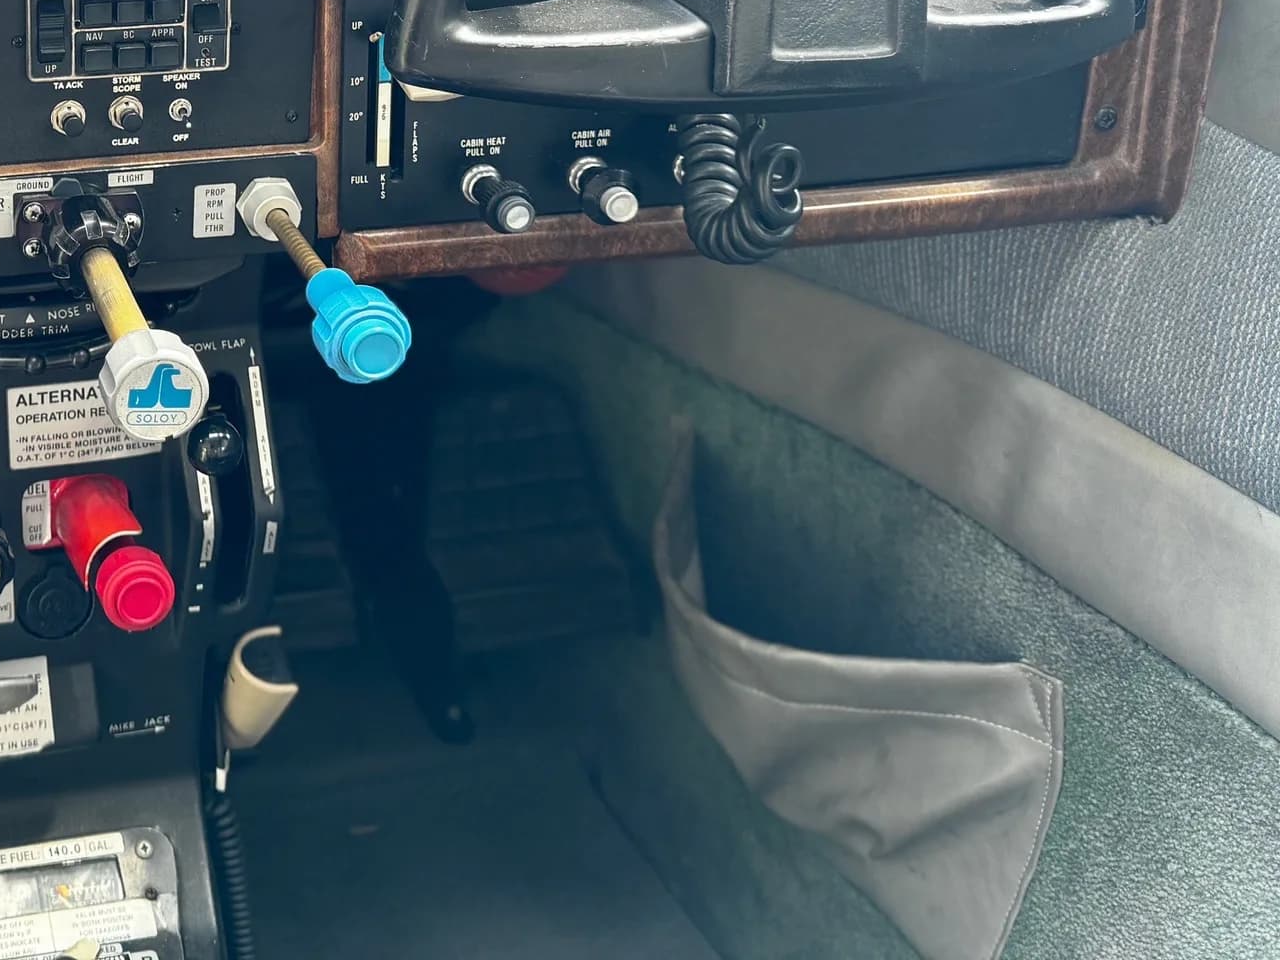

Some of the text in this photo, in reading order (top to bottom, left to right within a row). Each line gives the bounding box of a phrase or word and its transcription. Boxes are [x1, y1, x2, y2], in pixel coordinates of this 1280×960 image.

[86, 32, 103, 41] NAV
[151, 28, 175, 38] APPR
[198, 35, 213, 44] OFF
[195, 57, 216, 67] TEST
[112, 75, 141, 84] STORM
[163, 73, 200, 82] SPEAKER
[113, 83, 141, 92] SCOPE
[175, 82, 188, 90] ON
[173, 134, 189, 142] OFF
[572, 129, 611, 140] CABIN AIR
[111, 137, 139, 146] CLEAR
[461, 137, 506, 148] CABIN HEAT
[117, 173, 144, 184] FLIGHT
[16, 180, 50, 191] GROUND
[205, 187, 226, 197] PROP
[206, 199, 224, 209] RPM
[205, 212, 224, 222] PULL
[204, 224, 224, 233] FTHR
[38, 325, 69, 336] TRIM
[16, 409, 86, 425] OPERATION
[136, 414, 178, 423] SOLOY
[20, 739, 38, 748] USE
